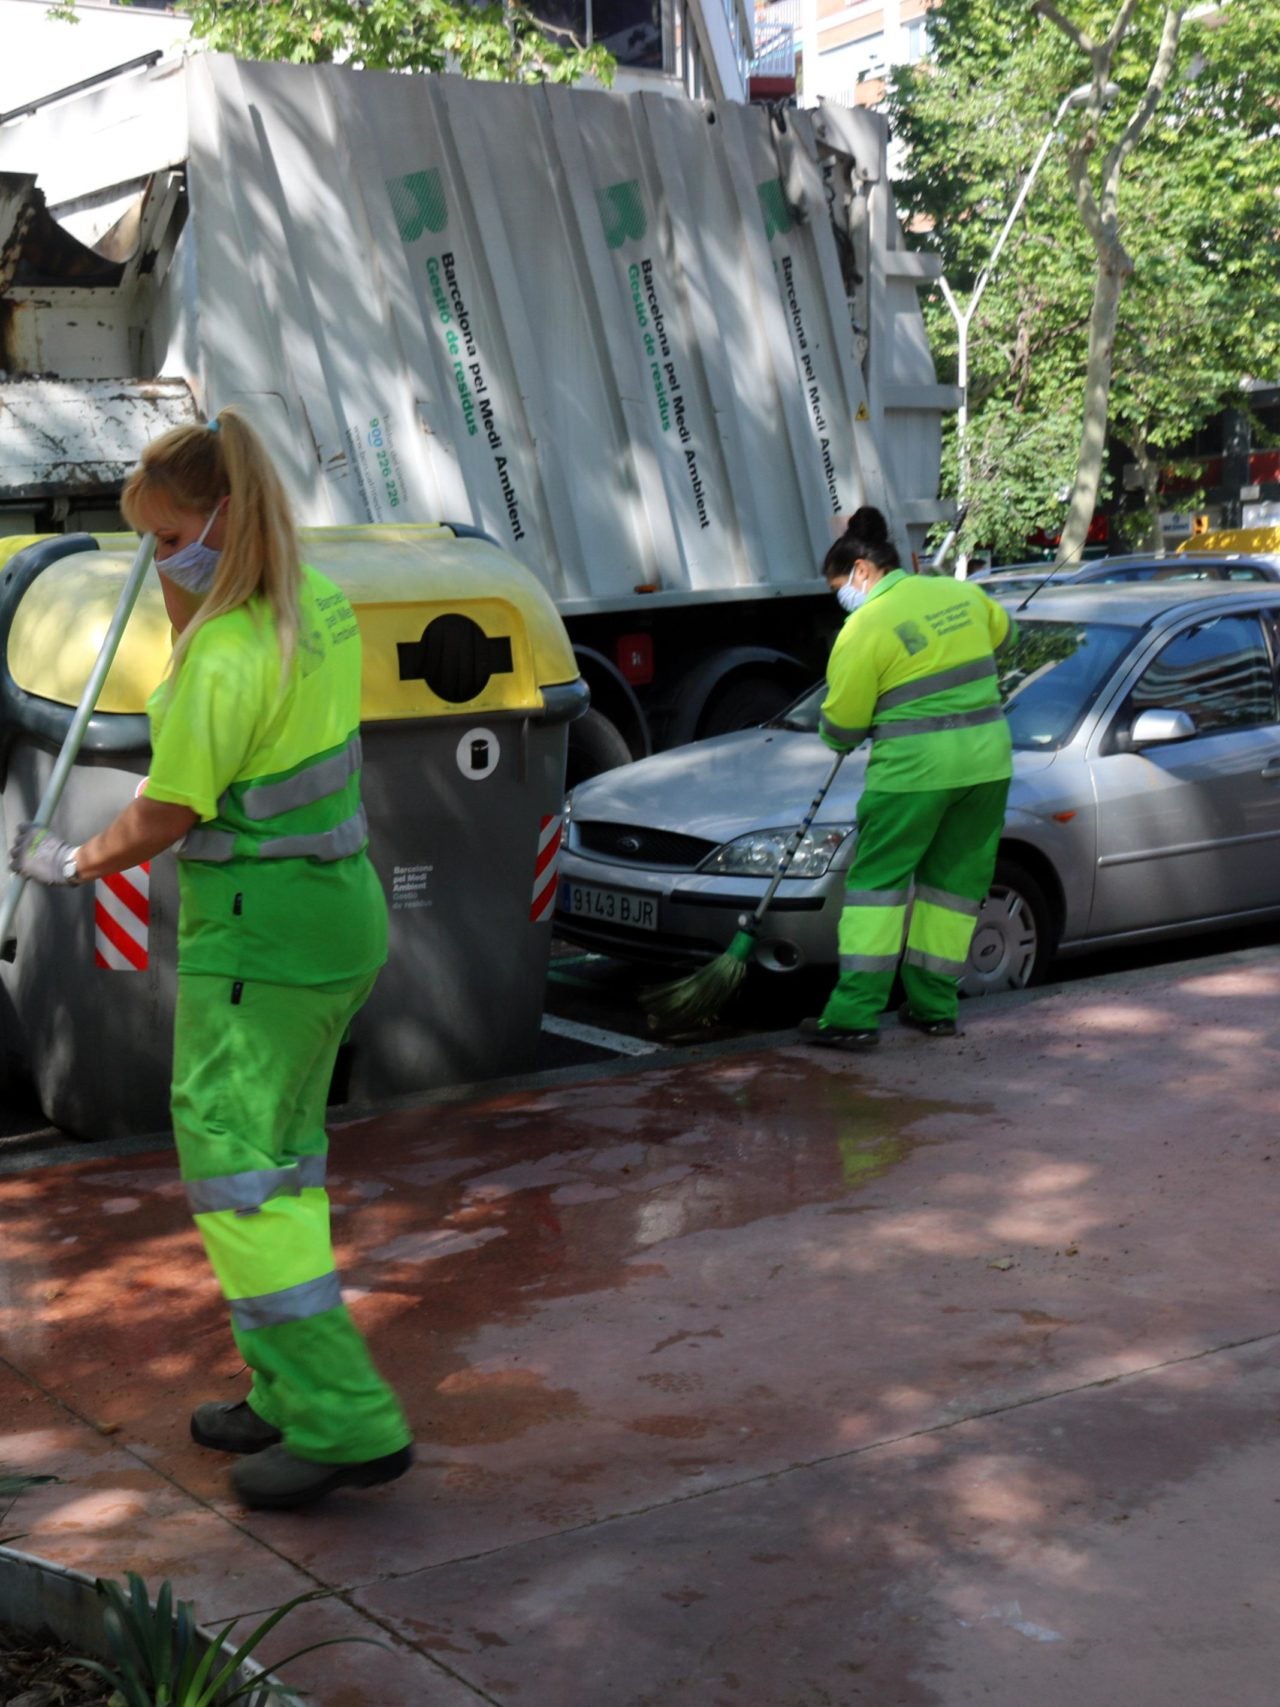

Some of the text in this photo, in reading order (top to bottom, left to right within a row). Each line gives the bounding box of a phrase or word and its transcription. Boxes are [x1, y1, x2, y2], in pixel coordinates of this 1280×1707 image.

[426, 257, 480, 437] Gestió de residus
[441, 252, 525, 542] Barcelona pel Medi Ambient
[628, 264, 671, 432] Gestió de residus
[641, 259, 711, 530] Barcelona pel Medi Ambient
[782, 256, 843, 515] Barcelona pel Medi Ambient
[368, 417, 400, 508] 900 226 226
[393, 865, 434, 875] Barcelona
[393, 873, 428, 885] pel Medi
[393, 882, 427, 893] Ambient
[573, 888, 654, 927] 9143 BJR
